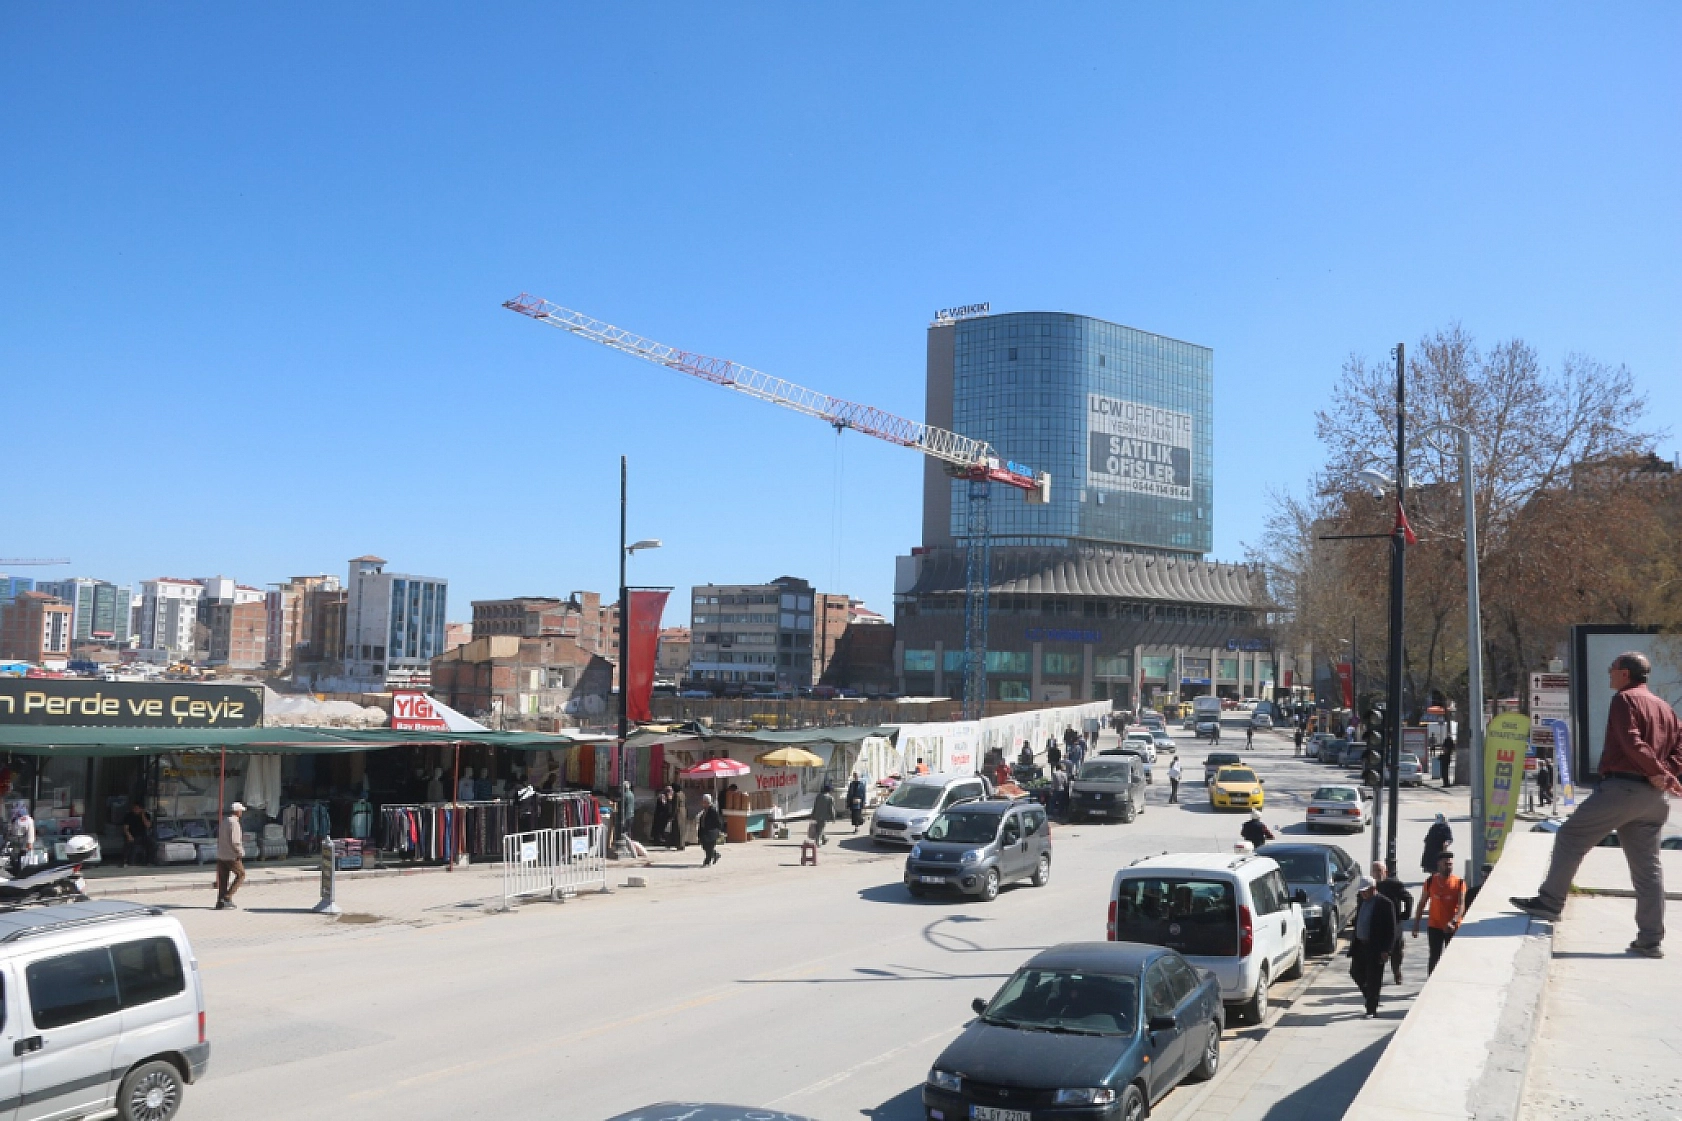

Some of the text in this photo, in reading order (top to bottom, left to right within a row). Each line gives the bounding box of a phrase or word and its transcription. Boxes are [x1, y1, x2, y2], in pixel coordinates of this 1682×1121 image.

[1091, 396, 1123, 417] LCW
[1109, 436, 1173, 465] SATILIK
[23, 691, 120, 716] Perde
[127, 697, 163, 717] ve
[170, 695, 245, 724] Çeyiz
[755, 770, 798, 790] Yeniden
[1490, 749, 1516, 806] BEBE
